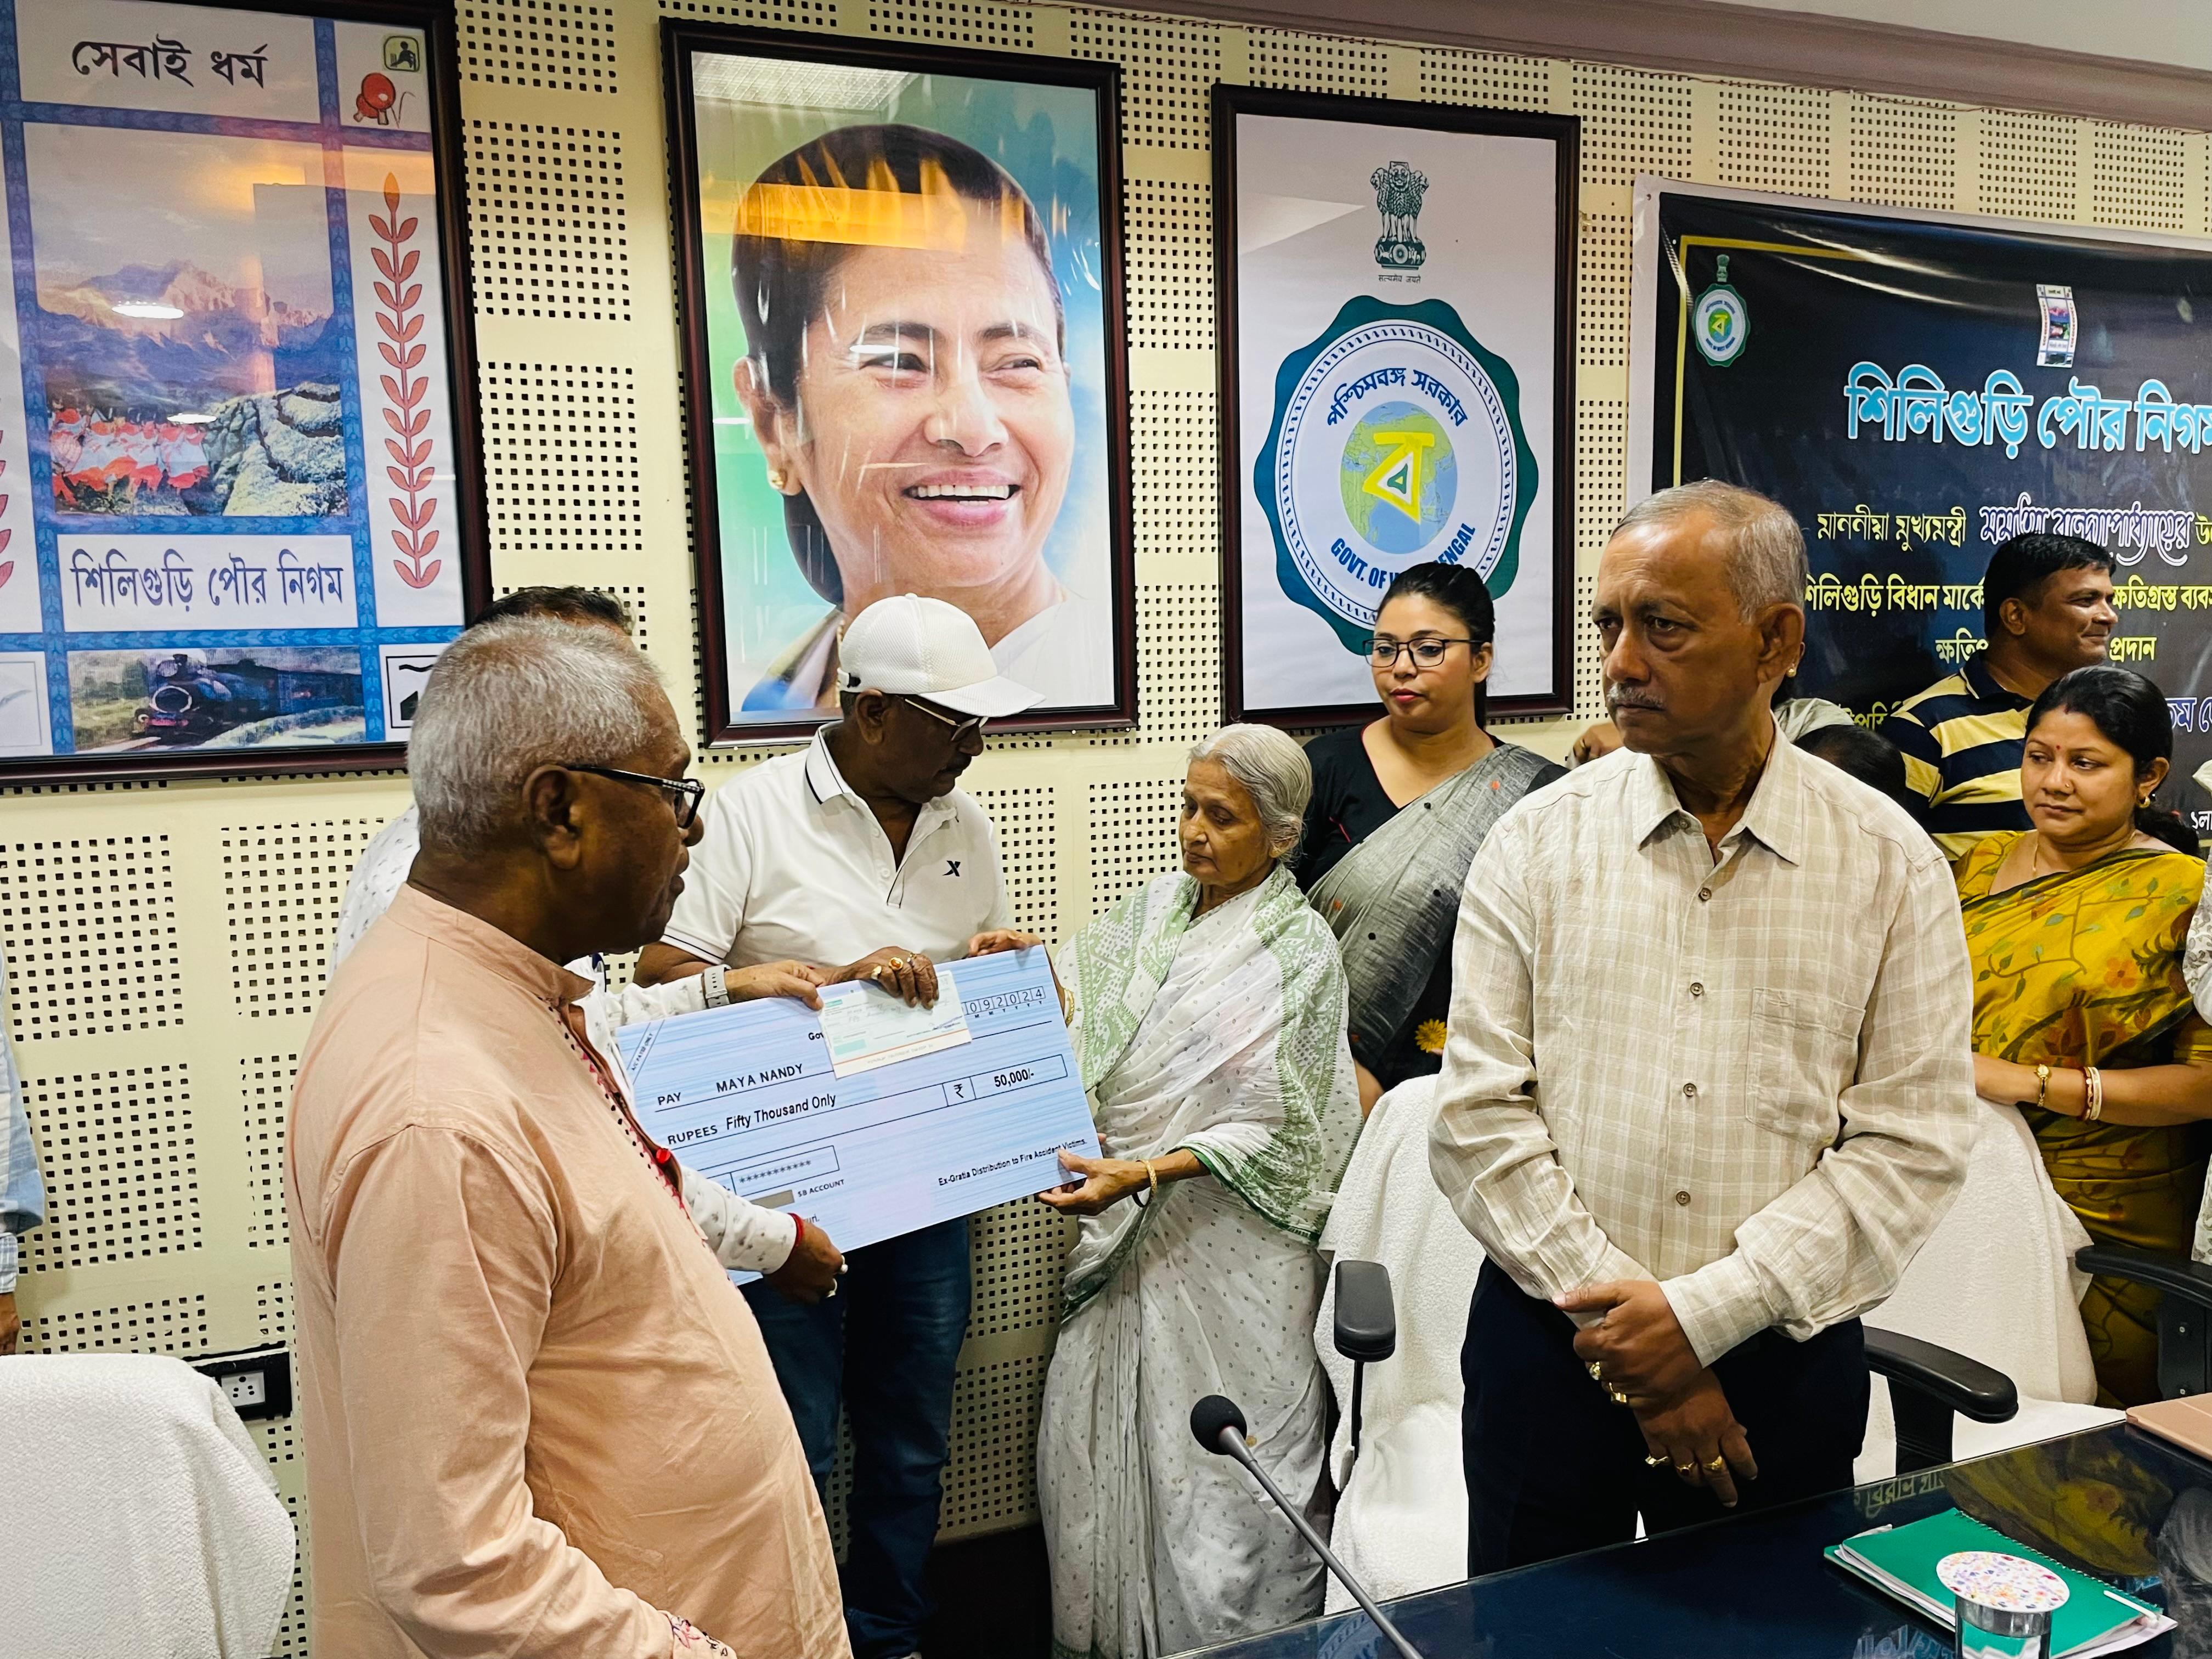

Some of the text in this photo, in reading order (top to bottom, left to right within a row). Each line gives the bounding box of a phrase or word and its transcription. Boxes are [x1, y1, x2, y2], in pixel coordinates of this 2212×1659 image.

[72, 33, 268, 89] সেবাই ধর্ম
[1328, 368, 1468, 426] পশ্চিমবঙ্গ সরকার
[1844, 361, 2034, 460] শিলিগুড়ি
[2037, 376, 2132, 452] পৌর
[1817, 504, 1889, 541] মাননীয়া
[1895, 506, 1966, 551] মুখ্যমন্ত্রী
[1331, 523, 1475, 589] GOVT. OF ENGAL
[70, 548, 344, 612] শিলিগুড়ি পৌর নিগম
[1886, 573, 1940, 611] বিধান
[2109, 636, 2157, 662] প্রদান
[658, 1063, 803, 1106] PAY MAYA NANDY
[994, 1068, 1034, 1087] 50,000/-
[667, 1093, 836, 1145] RUPEES Fifty Thousand Only
[809, 1179, 845, 1194] ACCOUNT
[972, 1160, 1011, 1176] Distribution
[1020, 1153, 1033, 1163] Fire
